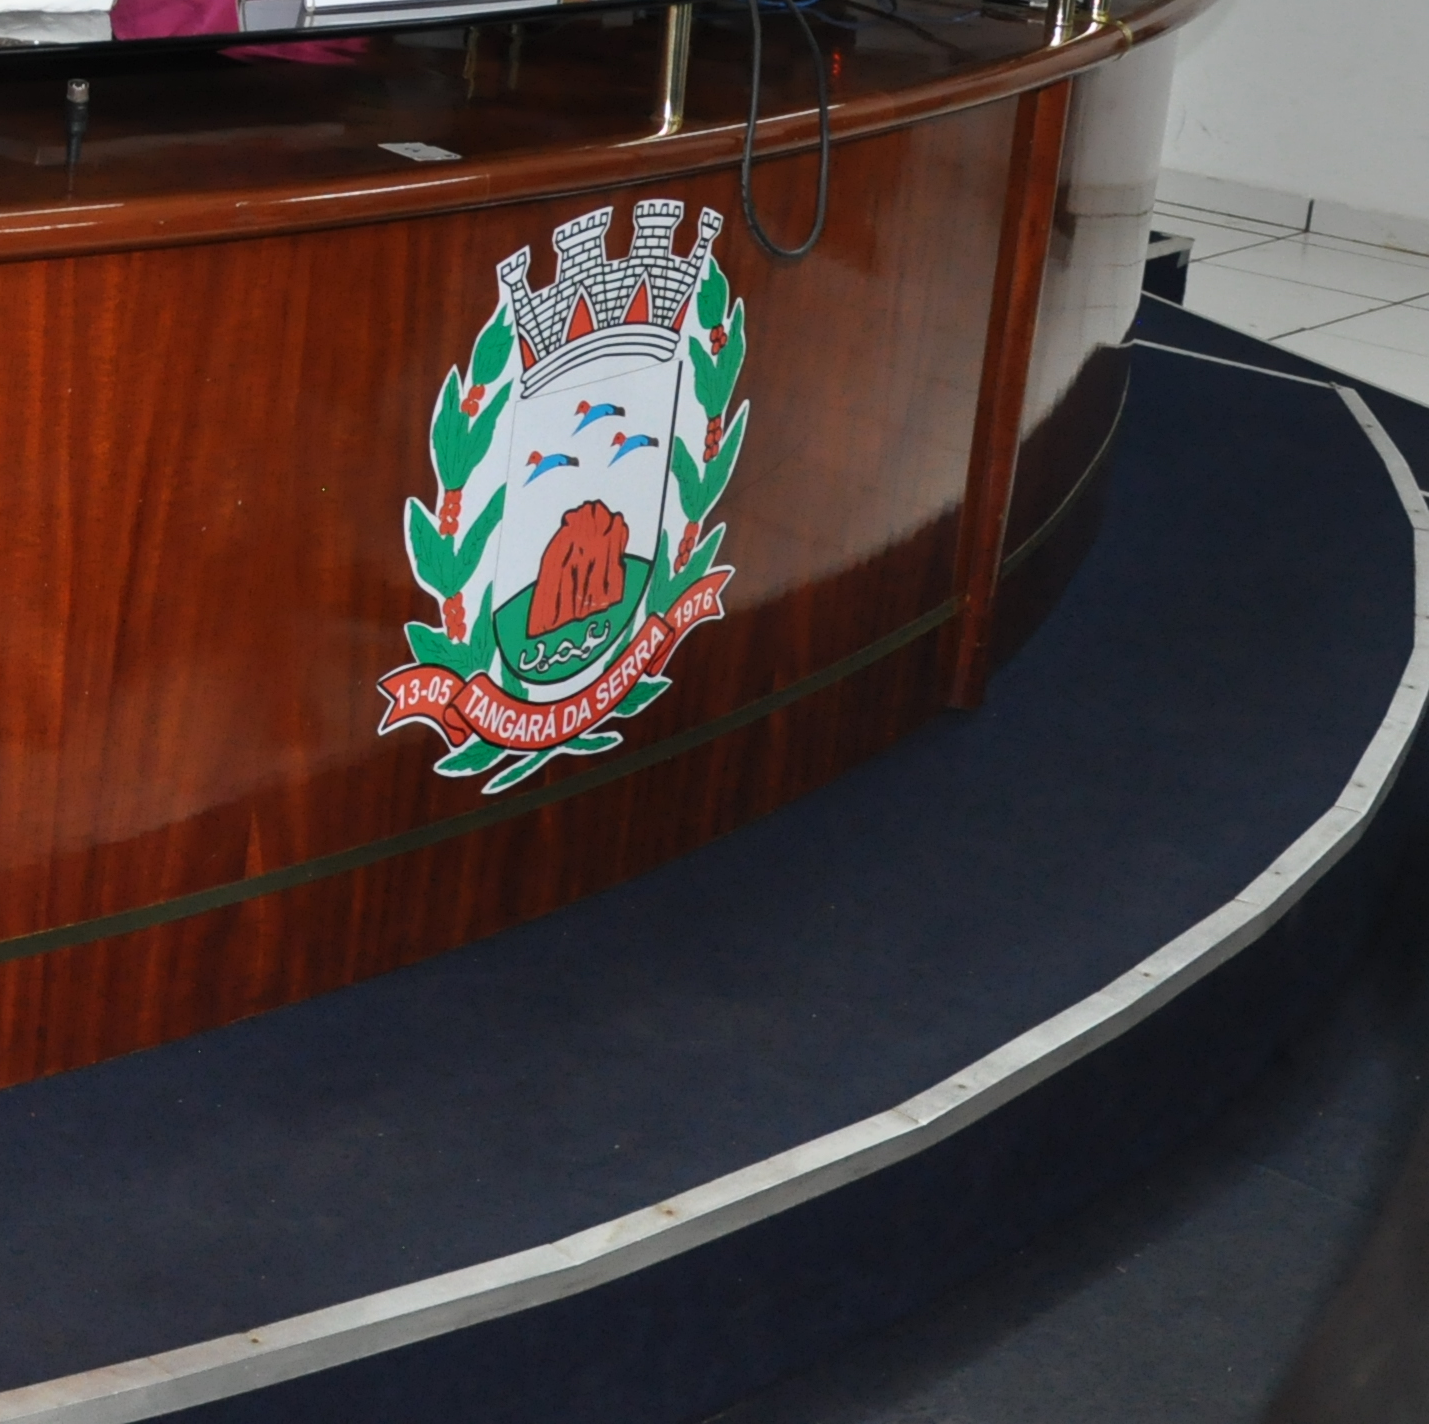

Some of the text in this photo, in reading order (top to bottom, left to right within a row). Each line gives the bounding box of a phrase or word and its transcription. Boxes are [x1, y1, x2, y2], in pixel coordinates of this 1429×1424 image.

[674, 587, 714, 627] 1976
[395, 675, 454, 711] 13-05
[463, 626, 666, 743] TANGARÁ DA SERRA
